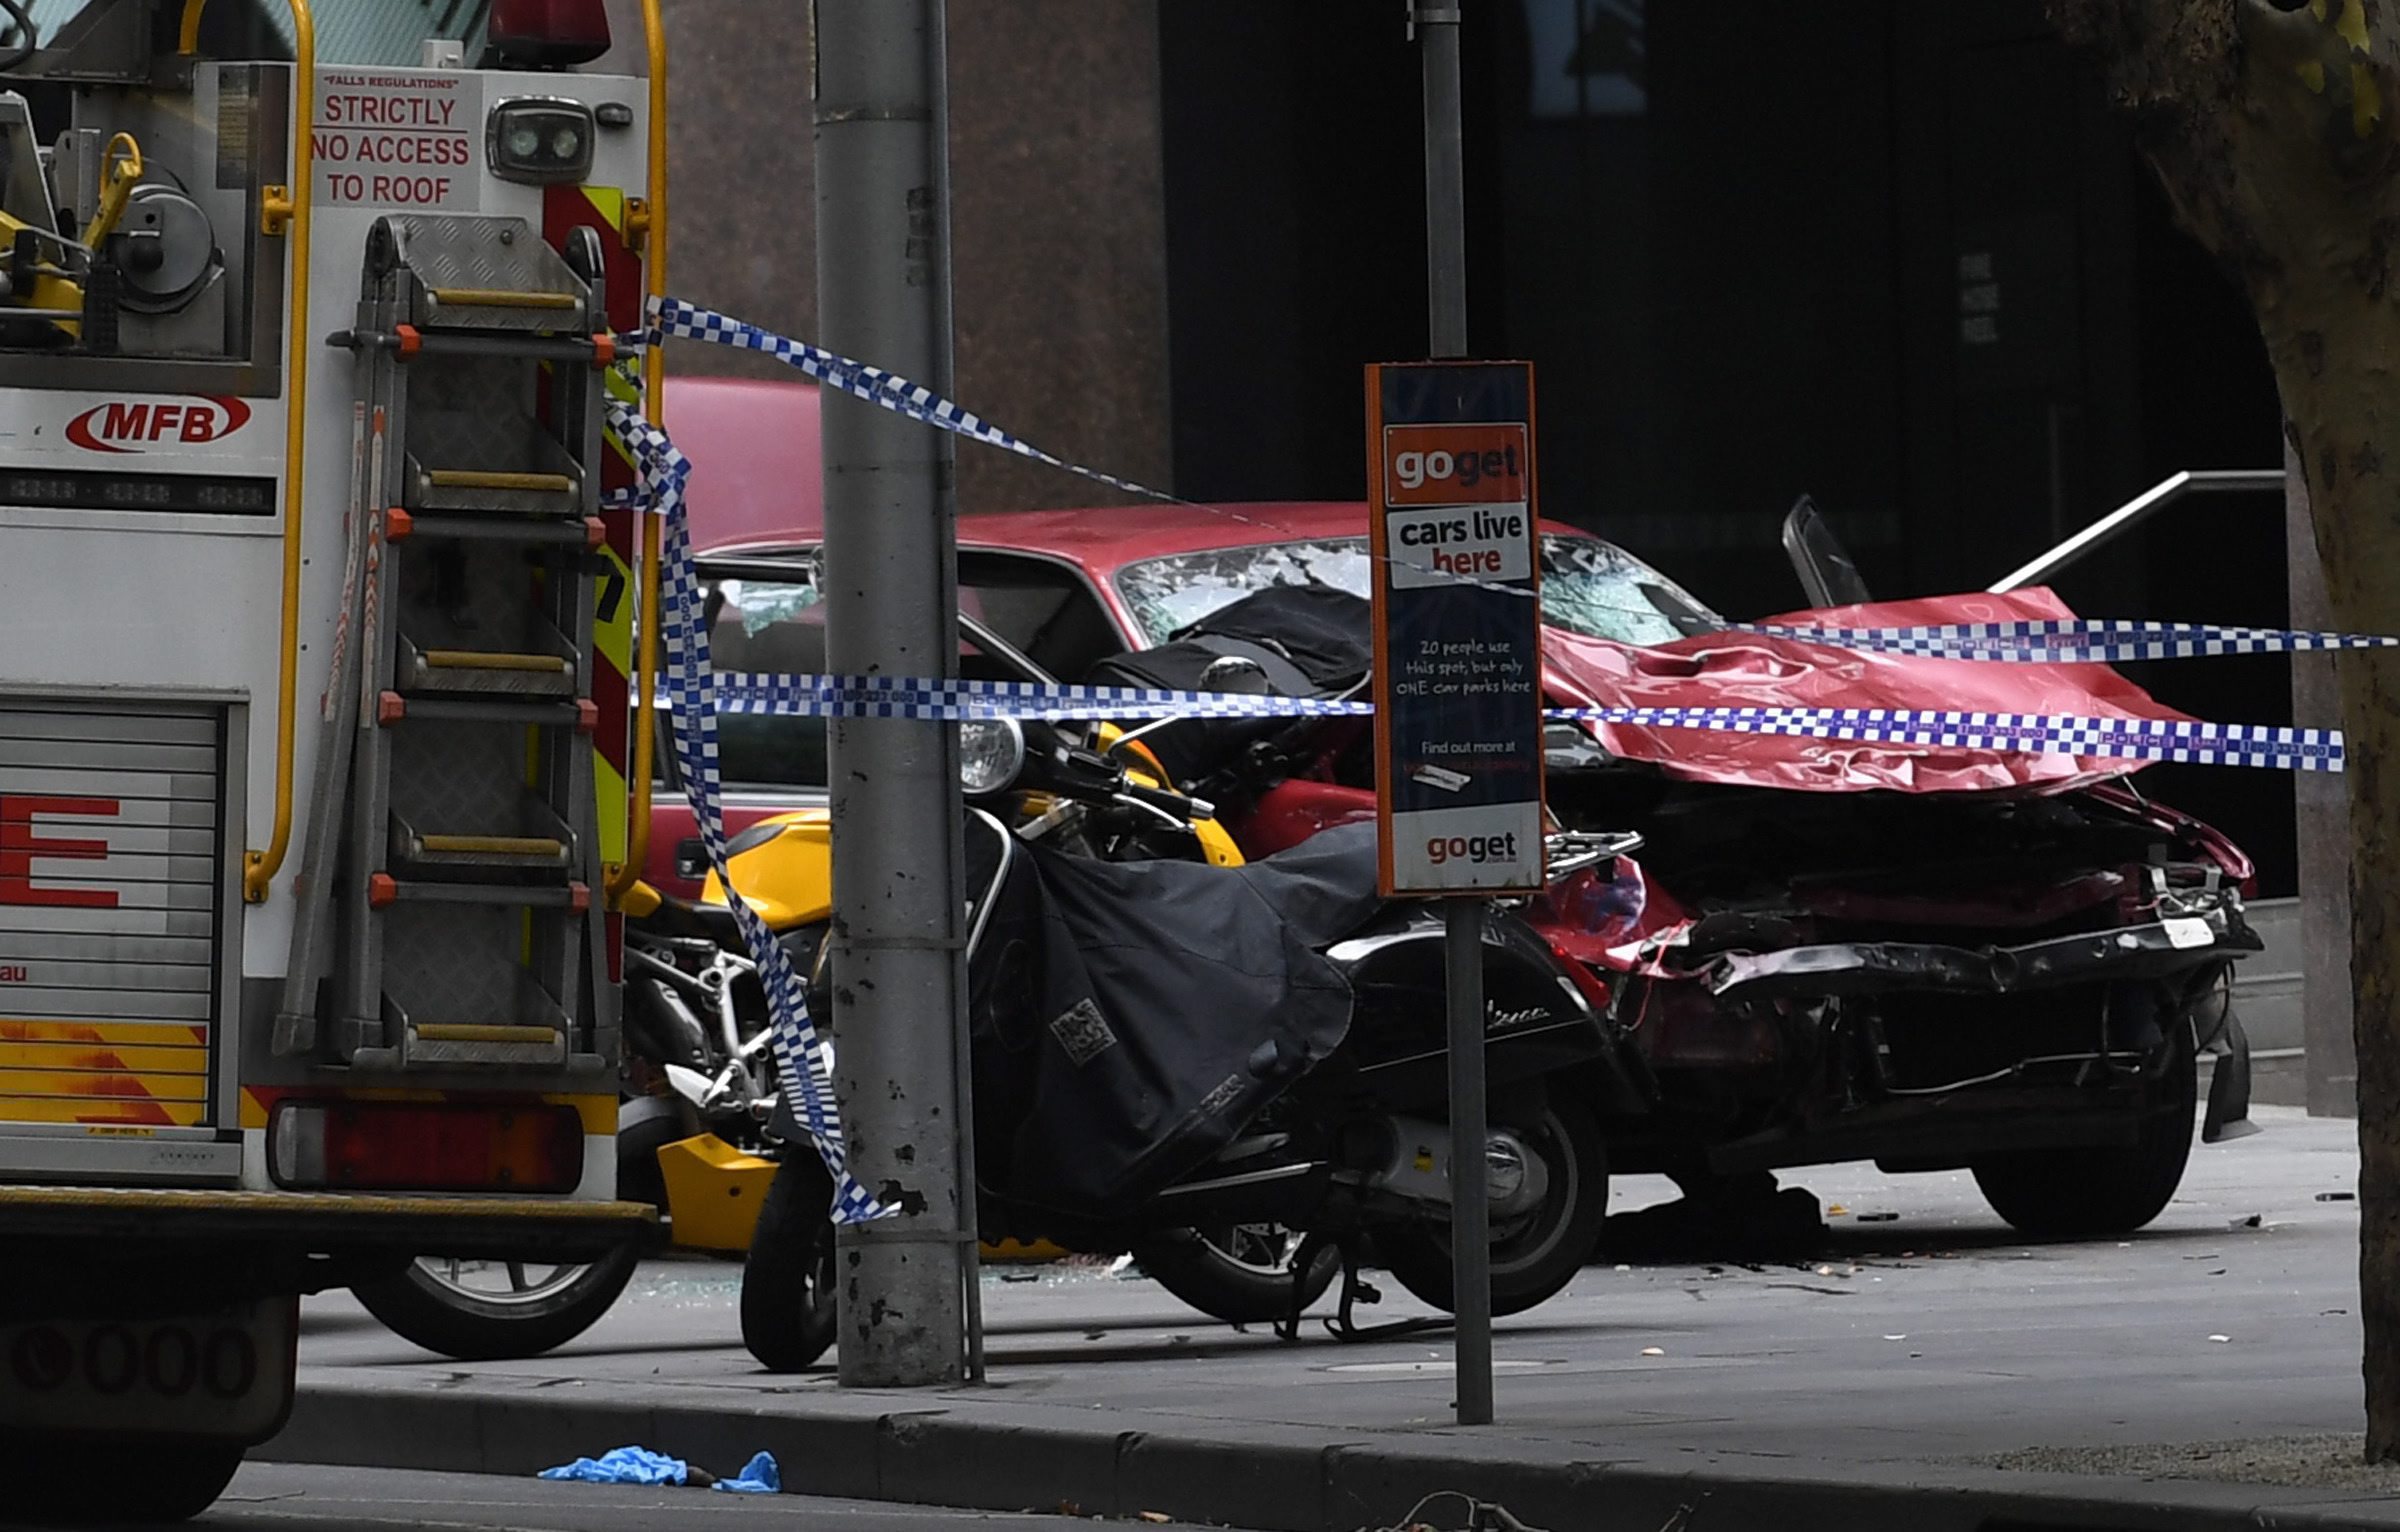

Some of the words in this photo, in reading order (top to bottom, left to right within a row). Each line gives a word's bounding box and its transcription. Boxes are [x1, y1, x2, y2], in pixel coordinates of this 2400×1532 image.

[325, 95, 455, 125] STRICTLY
[311, 134, 349, 161] NO
[356, 136, 469, 165] ACCESS
[327, 174, 363, 201] TO
[373, 175, 450, 203] ROOF
[103, 403, 214, 443] MFB
[1395, 444, 1518, 489] goget
[1400, 520, 1468, 546] cars
[1473, 511, 1522, 540] live
[1433, 548, 1502, 574] here
[1420, 640, 1440, 655] 20
[1443, 638, 1484, 657] people
[1488, 641, 1511, 652] use
[1406, 660, 1434, 673] this
[1438, 661, 1468, 676] spot,
[1472, 660, 1496, 673] but
[1500, 658, 1523, 675] only
[1396, 681, 1427, 695] ONE
[1433, 682, 1459, 694] car
[1462, 678, 1499, 696] parks
[1502, 679, 1531, 693] here
[1421, 741, 1448, 754] Find
[1449, 742, 1472, 754] out
[1473, 743, 1503, 753] more
[1504, 741, 1516, 752] at
[1426, 831, 1517, 864] goget
[85, 1324, 258, 1398] 000
